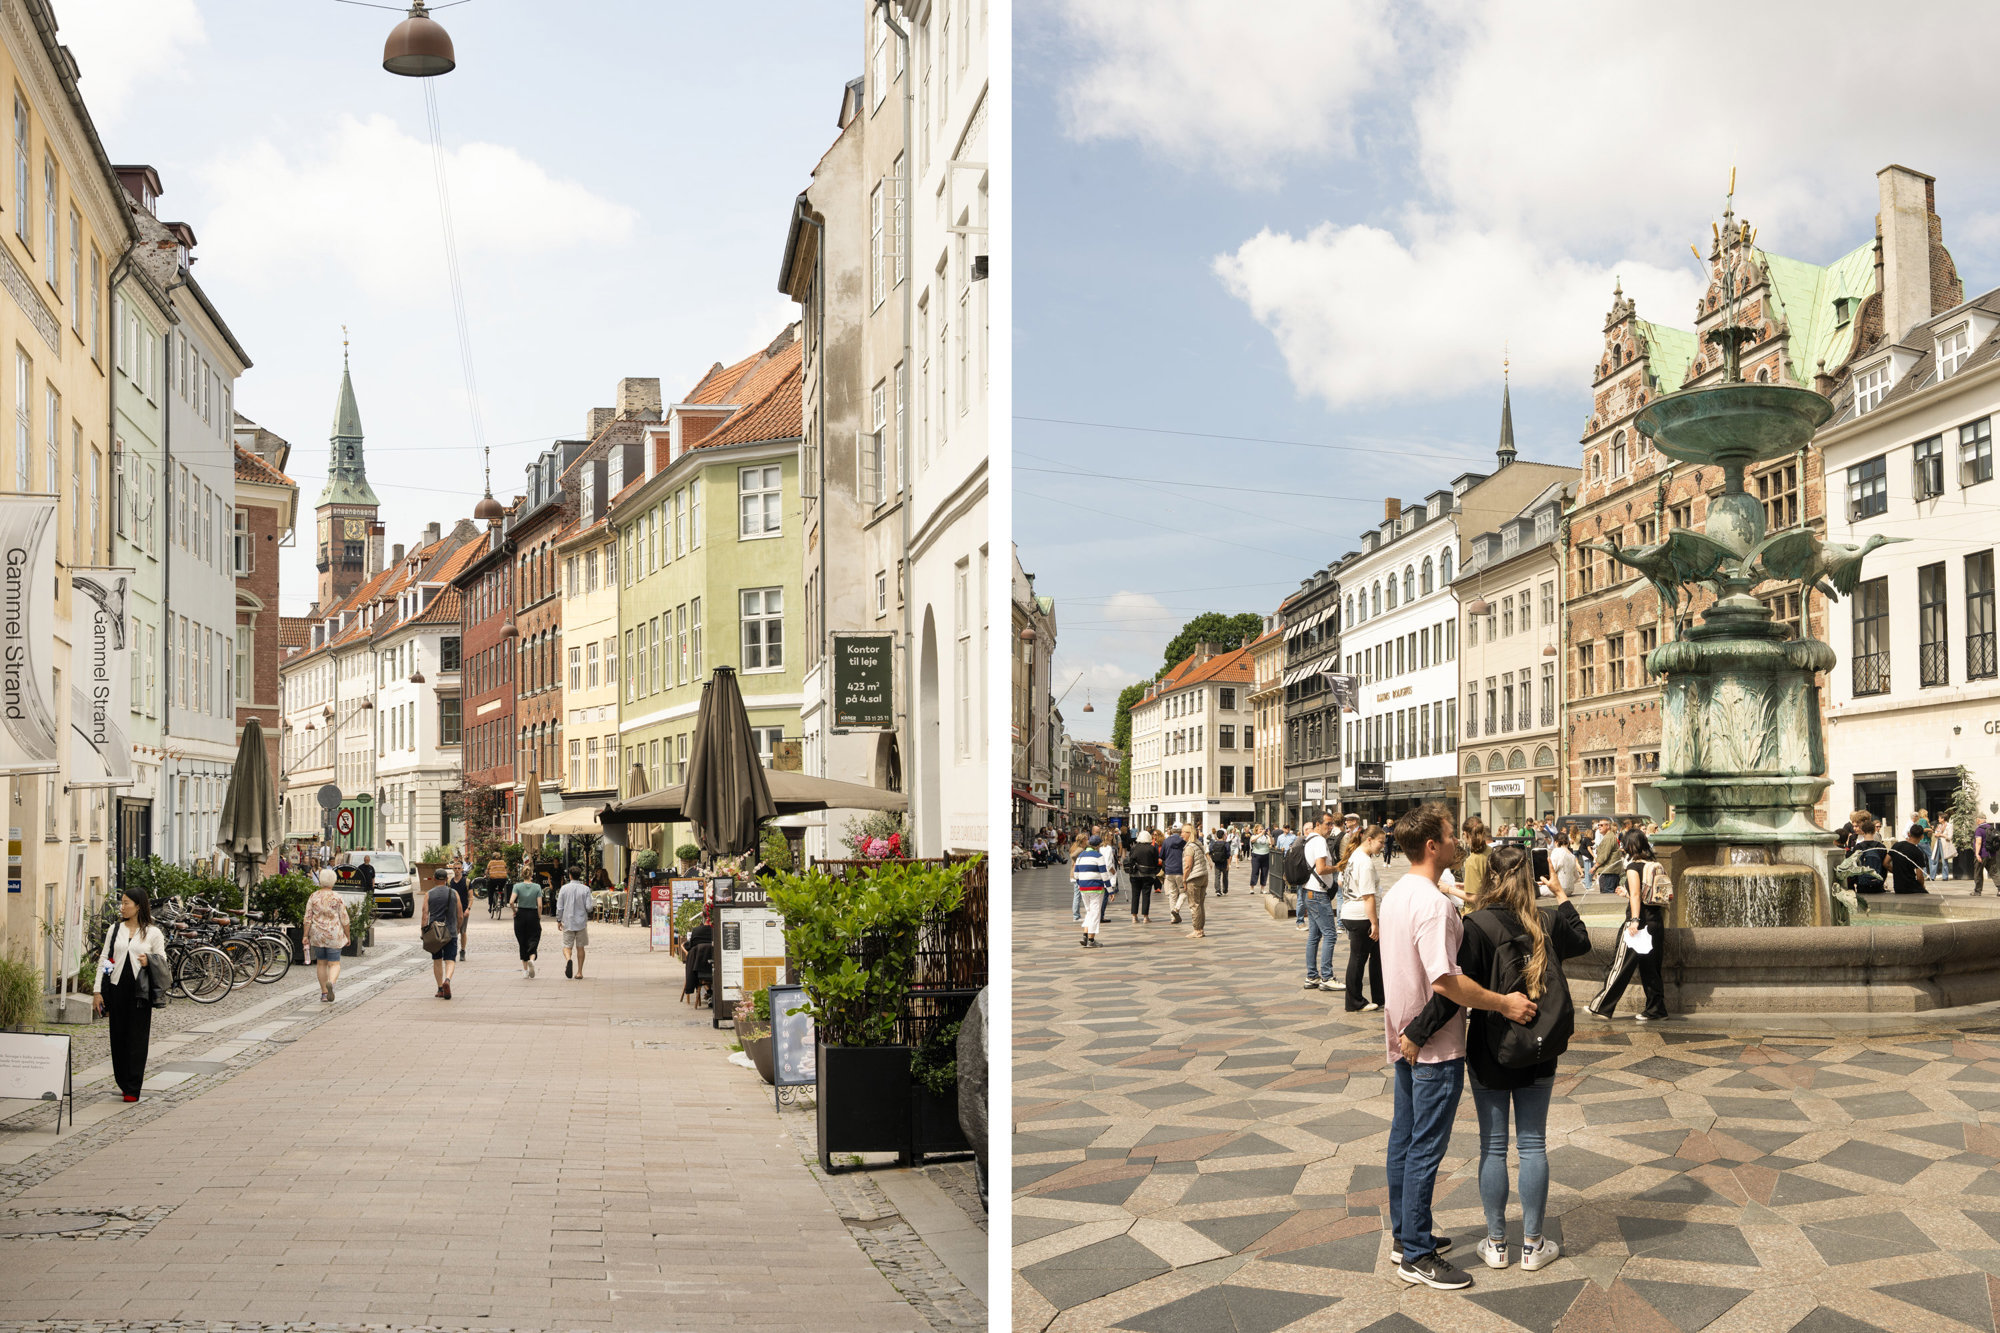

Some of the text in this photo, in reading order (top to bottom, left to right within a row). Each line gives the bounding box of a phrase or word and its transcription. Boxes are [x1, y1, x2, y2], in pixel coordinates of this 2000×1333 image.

[5, 547, 27, 720] Gammel Strand
[847, 645, 880, 654] Kontor
[849, 657, 878, 667] til leje
[93, 610, 110, 744] Gammel Strand
[847, 682, 865, 691] 423
[845, 694, 882, 705] på 4.sal
